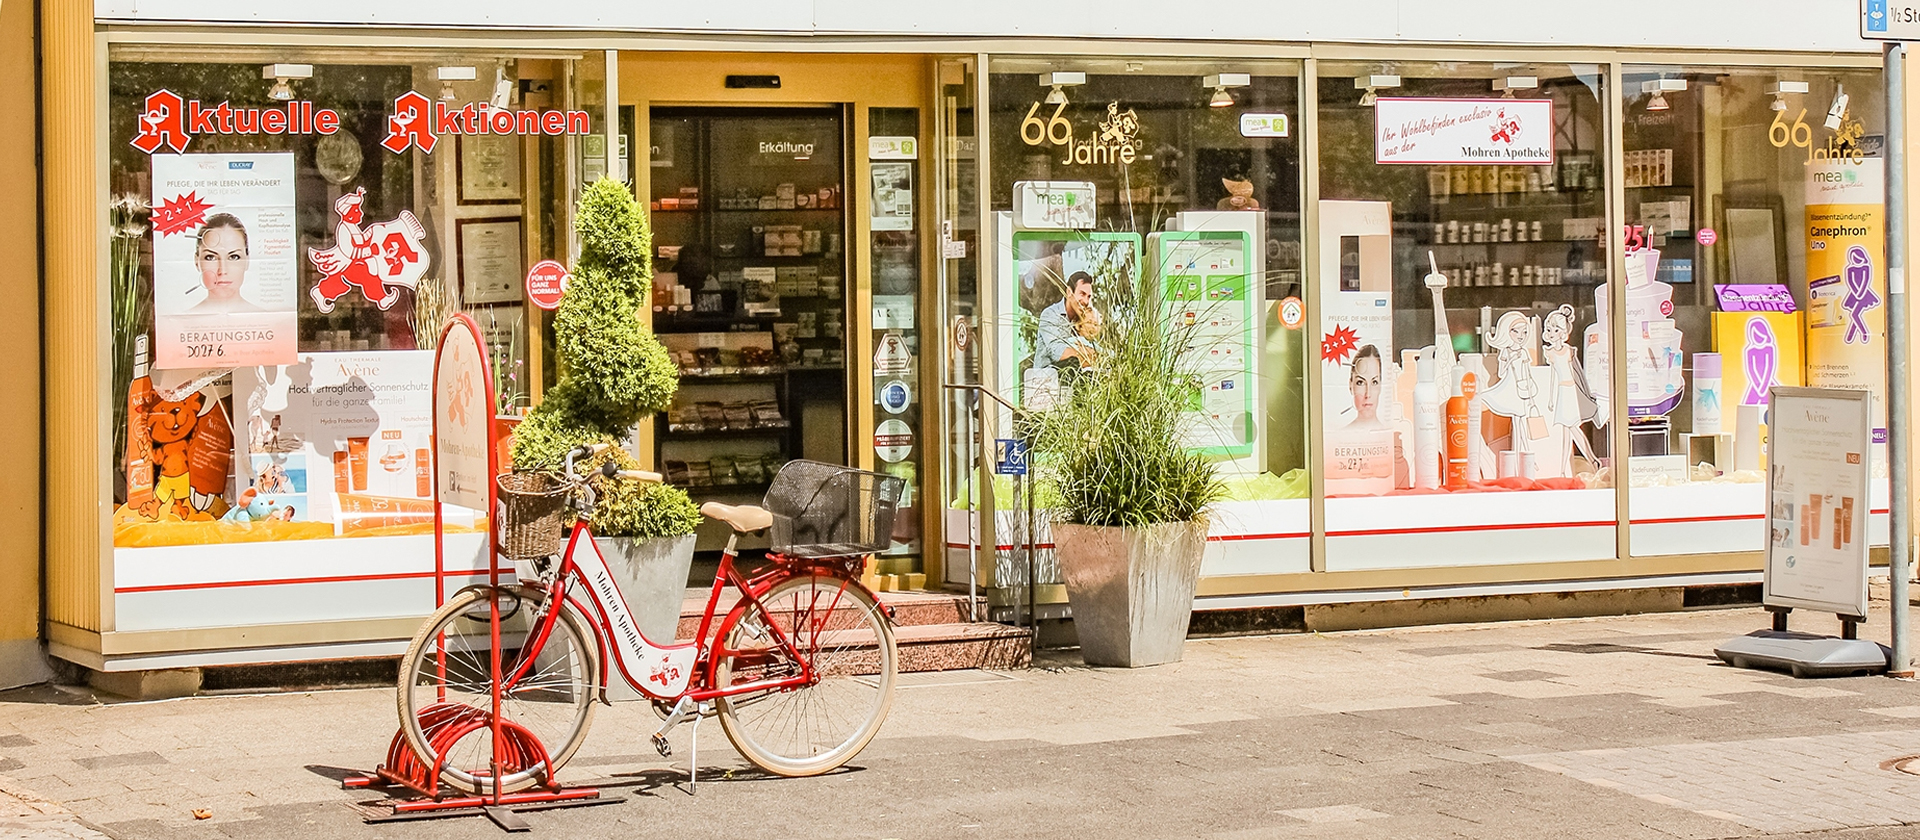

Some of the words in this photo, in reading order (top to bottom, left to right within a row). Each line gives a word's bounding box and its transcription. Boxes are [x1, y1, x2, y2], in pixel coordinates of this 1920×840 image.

[1904, 7, 1920, 23] St
[130, 88, 340, 154] Aktuelle
[380, 90, 590, 155] Aktionen
[1020, 101, 1073, 146] 66
[1382, 127, 1397, 143] Ihr
[1401, 113, 1456, 140] Wohlbefinden
[1459, 106, 1492, 124] exclusiv
[1769, 107, 1812, 148] 66
[759, 142, 814, 155] Erkältung
[1062, 131, 1137, 165] Jahre
[1384, 146, 1398, 157] aus
[1401, 139, 1416, 152] der
[1461, 146, 1501, 158] Mohren
[1503, 146, 1550, 160] Apotheke
[1803, 136, 1864, 166] Jahre
[167, 180, 193, 188] PFLEGE,
[242, 178, 281, 187] VERÄNDERT
[1813, 171, 1842, 182] mea
[1036, 193, 1064, 205] mea
[1810, 241, 1826, 249] Uno
[180, 330, 274, 343] BERATUNGSTAG
[1323, 343, 1332, 354] 2
[336, 363, 380, 378] Avène
[369, 381, 429, 392] Sonnenschutz
[312, 396, 323, 407] für
[326, 397, 340, 407] die
[342, 398, 369, 409] ganze
[1804, 410, 1830, 423] Avène
[1334, 446, 1389, 457] BERATUNGSTAG
[1847, 454, 1860, 464] NEU
[594, 570, 620, 613] Mohren
[616, 610, 645, 661] Apotheke
